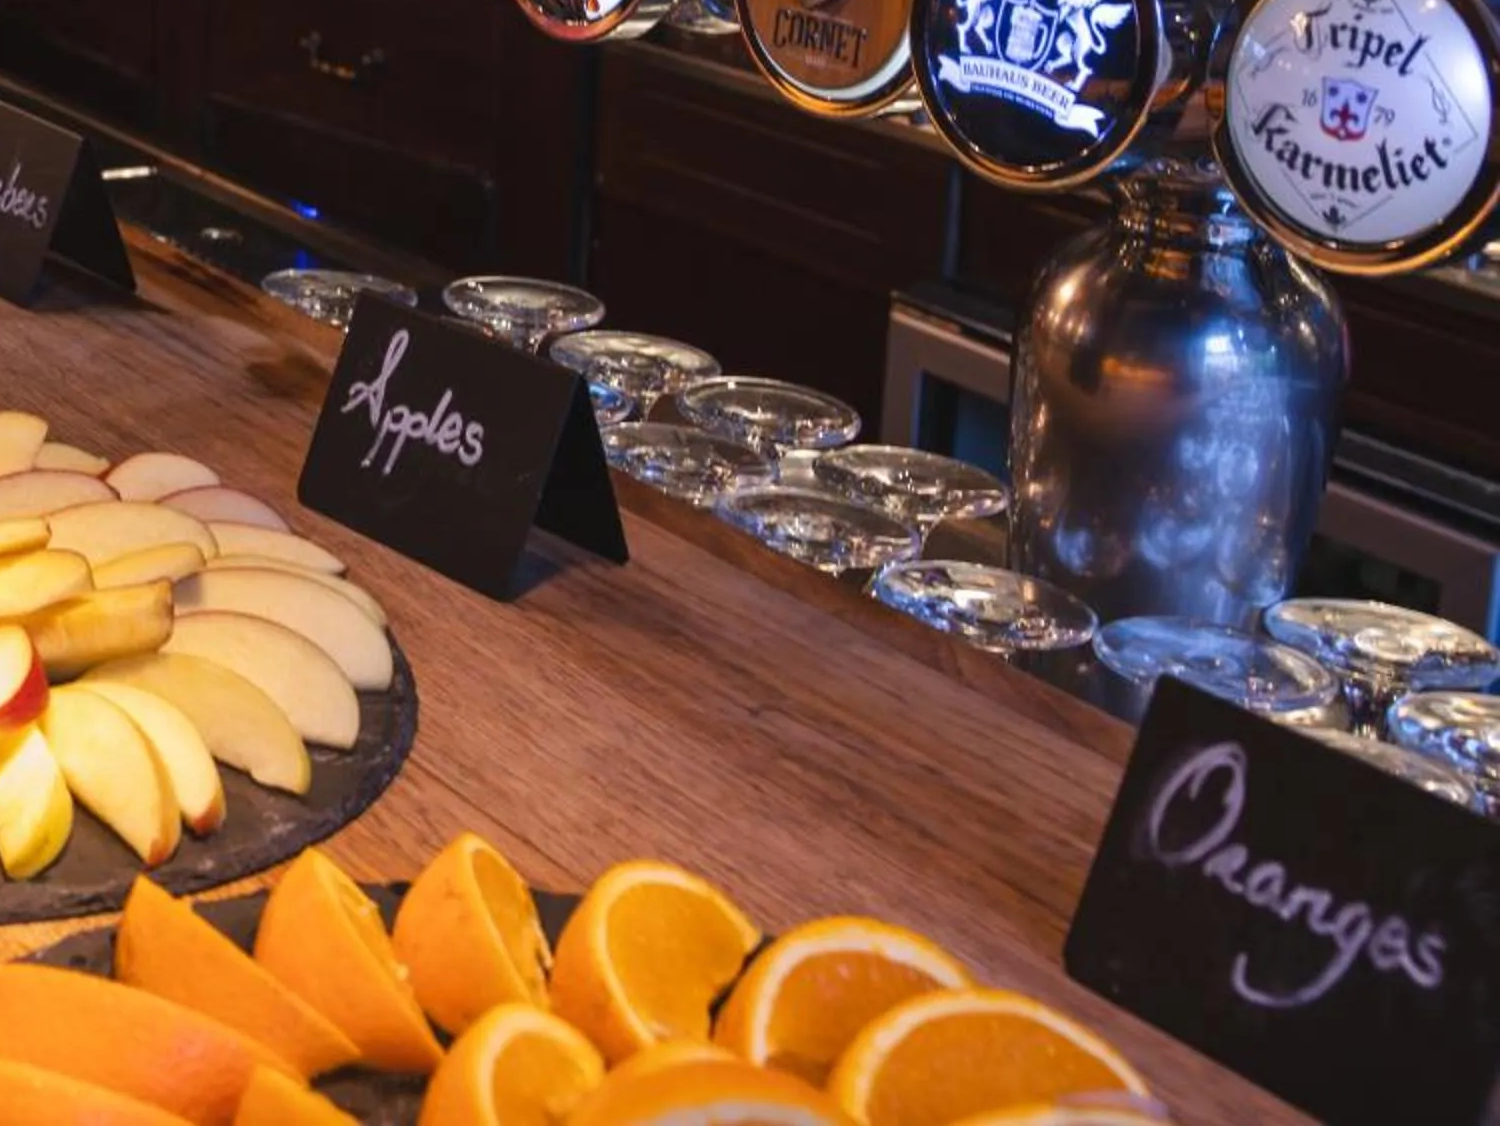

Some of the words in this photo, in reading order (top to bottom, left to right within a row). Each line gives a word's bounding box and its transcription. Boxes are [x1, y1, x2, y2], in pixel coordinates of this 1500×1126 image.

[773, 9, 867, 69] CORNET
[1292, 2, 1430, 76] Tripel
[963, 61, 1029, 90] BAUHAUS
[1030, 80, 1071, 111] BEER
[1252, 102, 1448, 194] Karmeliet
[340, 328, 485, 476] Apples
[1150, 741, 1447, 1008] Oranges
